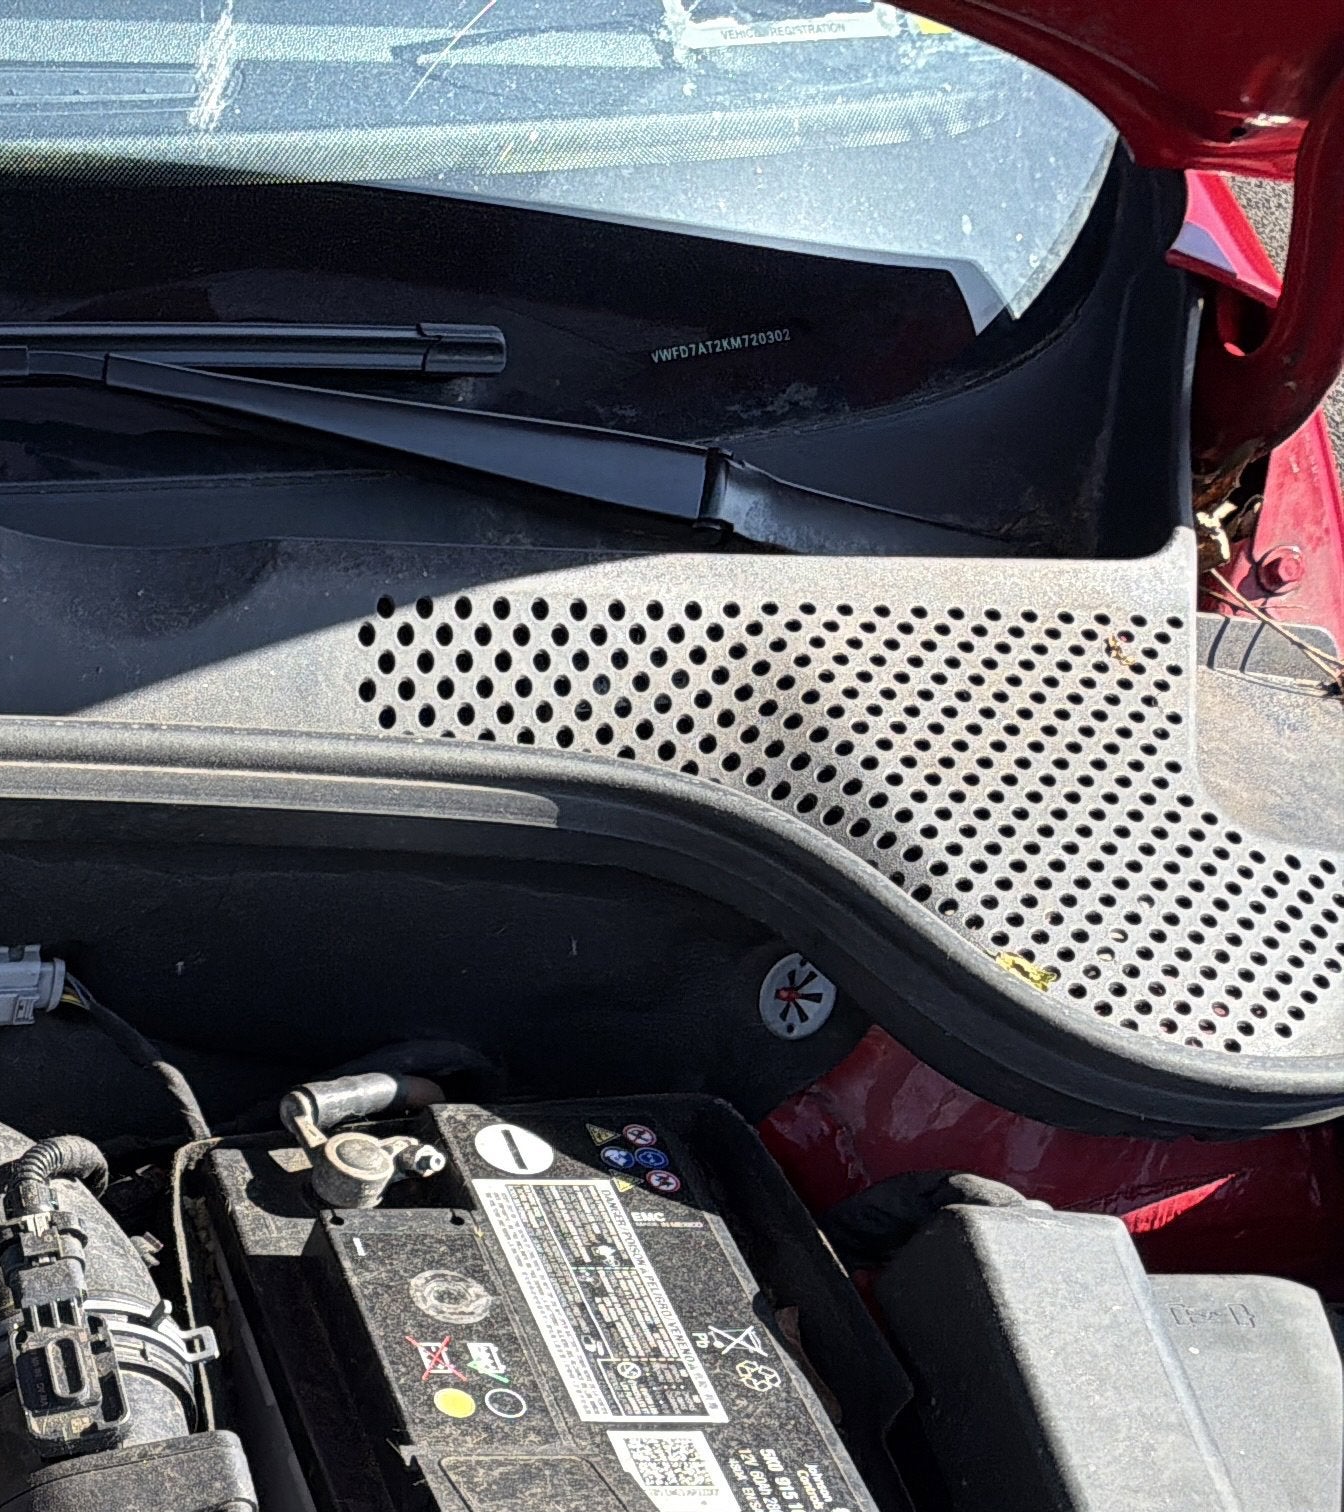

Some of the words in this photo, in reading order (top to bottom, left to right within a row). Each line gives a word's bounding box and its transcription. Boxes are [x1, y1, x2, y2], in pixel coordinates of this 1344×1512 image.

[769, 22, 846, 37] REGISTRATION
[651, 328, 791, 364] VWFD7AT2KM720302
[737, 1448, 759, 1467] 12V
[749, 1470, 773, 1497] 60Ah
[774, 1476, 799, 1501] 915
[796, 1469, 825, 1510] Controls
[804, 1463, 833, 1503] Johnson
